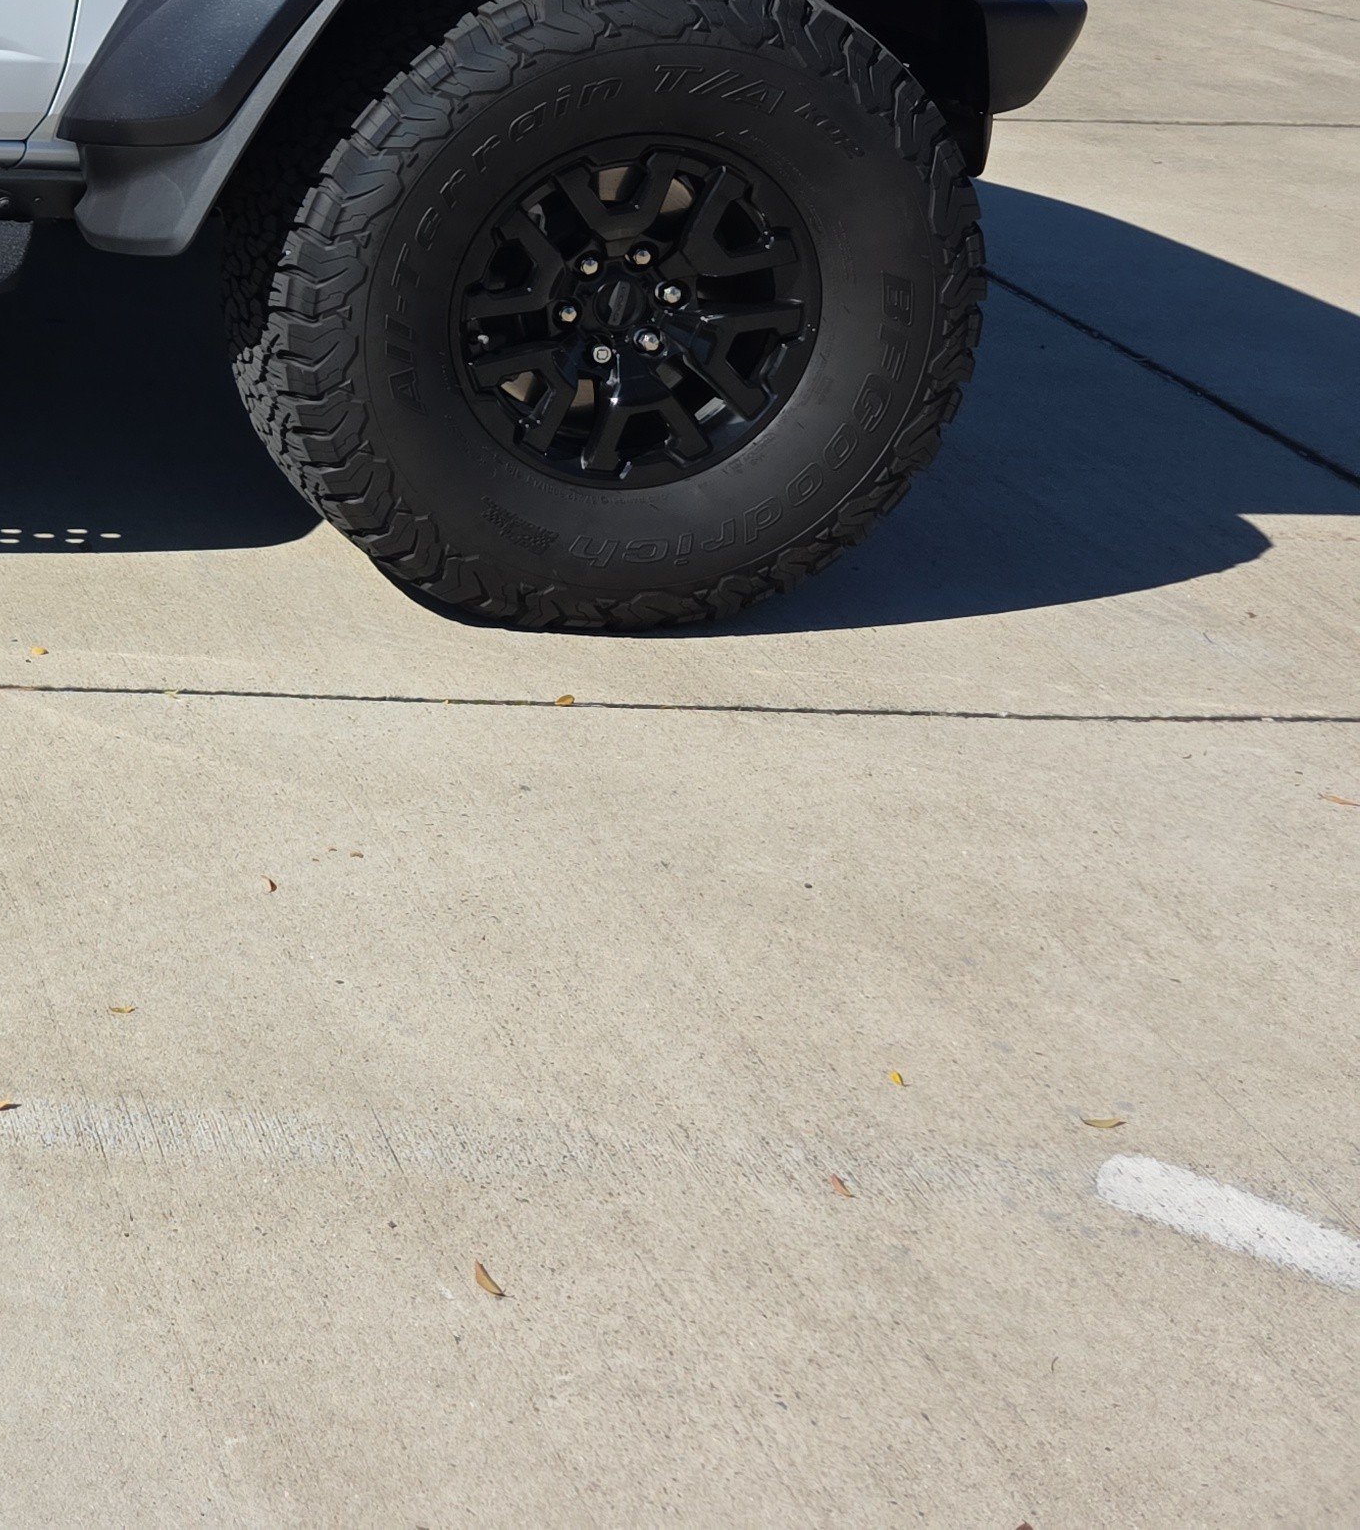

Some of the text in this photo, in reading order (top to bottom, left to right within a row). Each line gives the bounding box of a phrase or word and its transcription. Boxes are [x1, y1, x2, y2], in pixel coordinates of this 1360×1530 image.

[383, 75, 624, 413] All-Terrain
[651, 62, 786, 117] T/A
[567, 271, 916, 569] BFGoodrich
